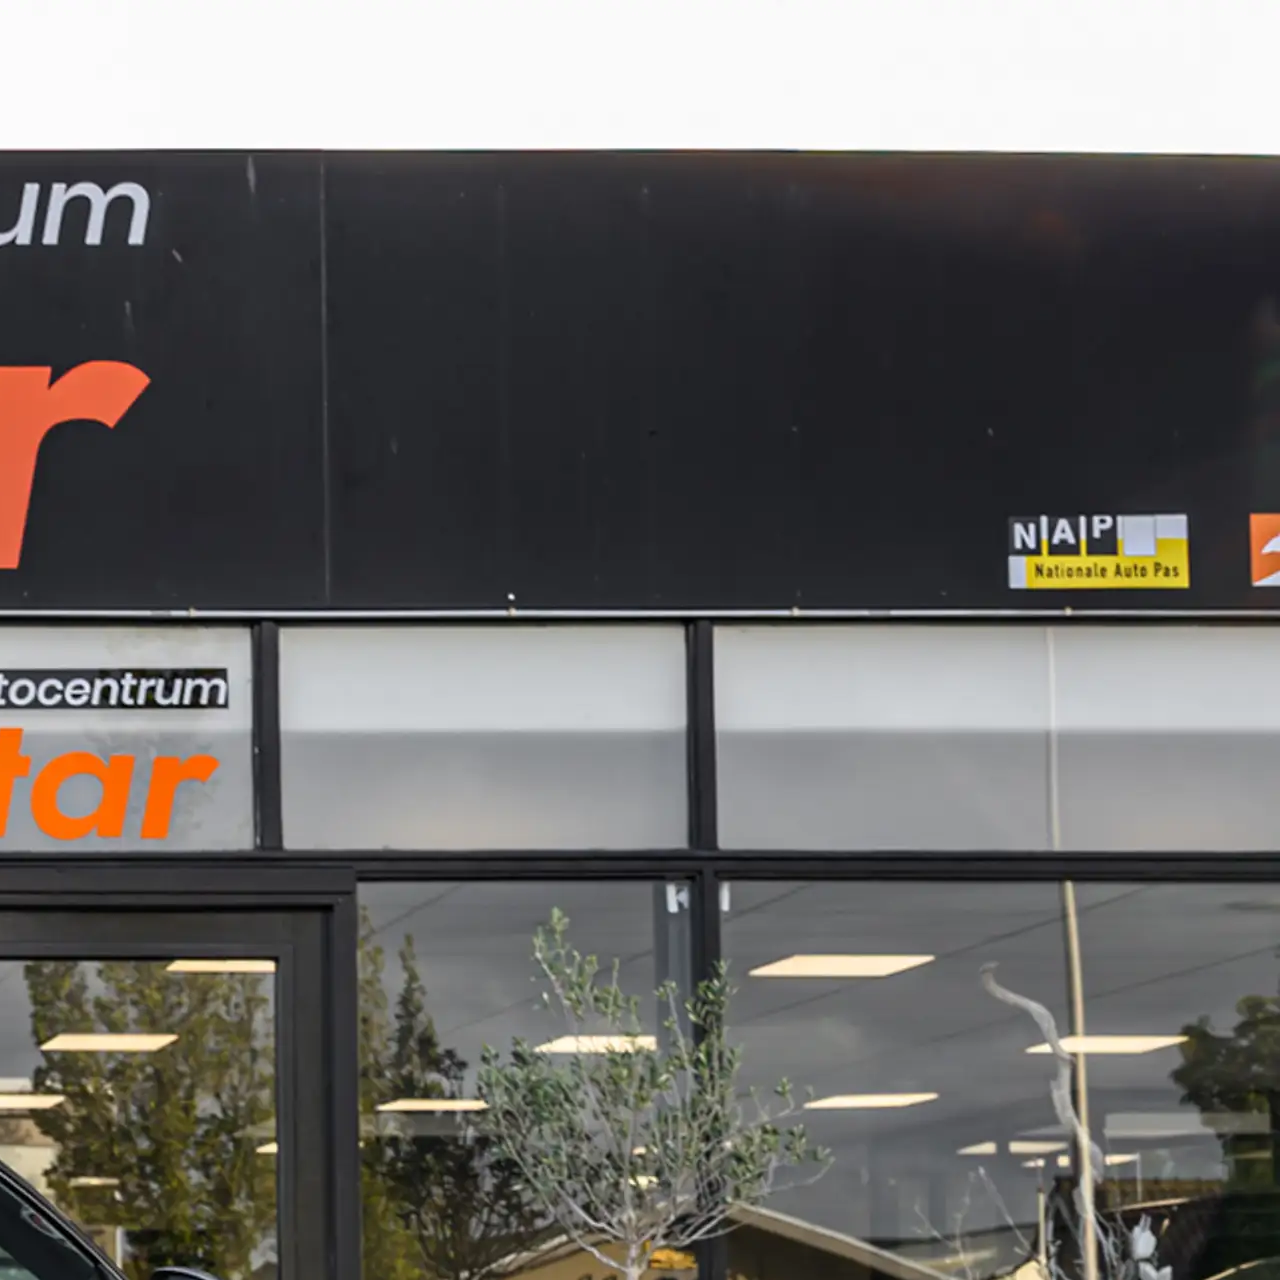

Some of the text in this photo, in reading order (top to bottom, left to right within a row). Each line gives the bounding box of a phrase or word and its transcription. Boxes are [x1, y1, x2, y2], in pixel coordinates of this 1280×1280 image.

[1034, 561, 1180, 579] Nationale Auto Pas
